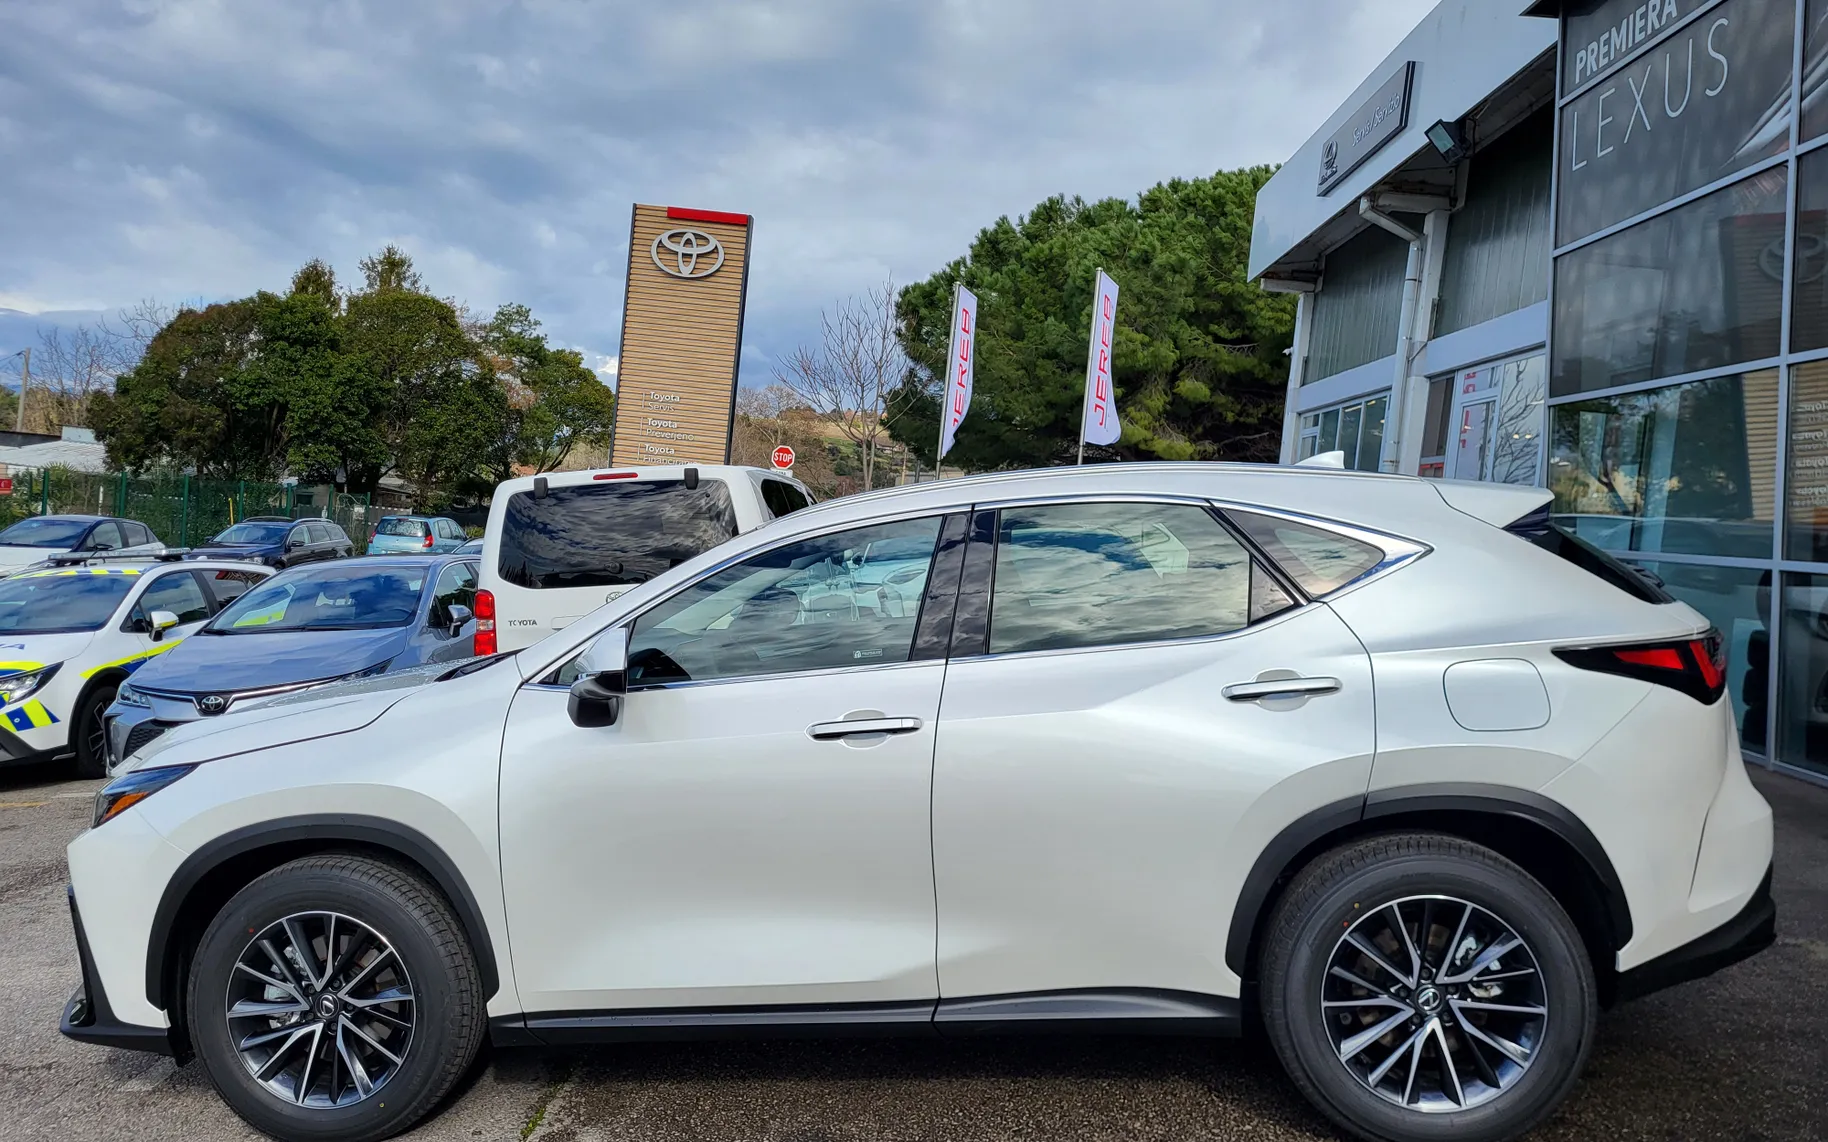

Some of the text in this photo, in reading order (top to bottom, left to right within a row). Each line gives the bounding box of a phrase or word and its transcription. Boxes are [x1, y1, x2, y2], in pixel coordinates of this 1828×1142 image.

[1575, 0, 1678, 84] PREMIERA
[1572, 17, 1729, 171] LEXUS
[650, 391, 680, 402] Toyota
[648, 401, 675, 412] Servis
[647, 418, 678, 428] Toyota
[646, 428, 695, 441] Preverjeno
[644, 443, 675, 455] Toyota
[773, 452, 793, 463] STOP
